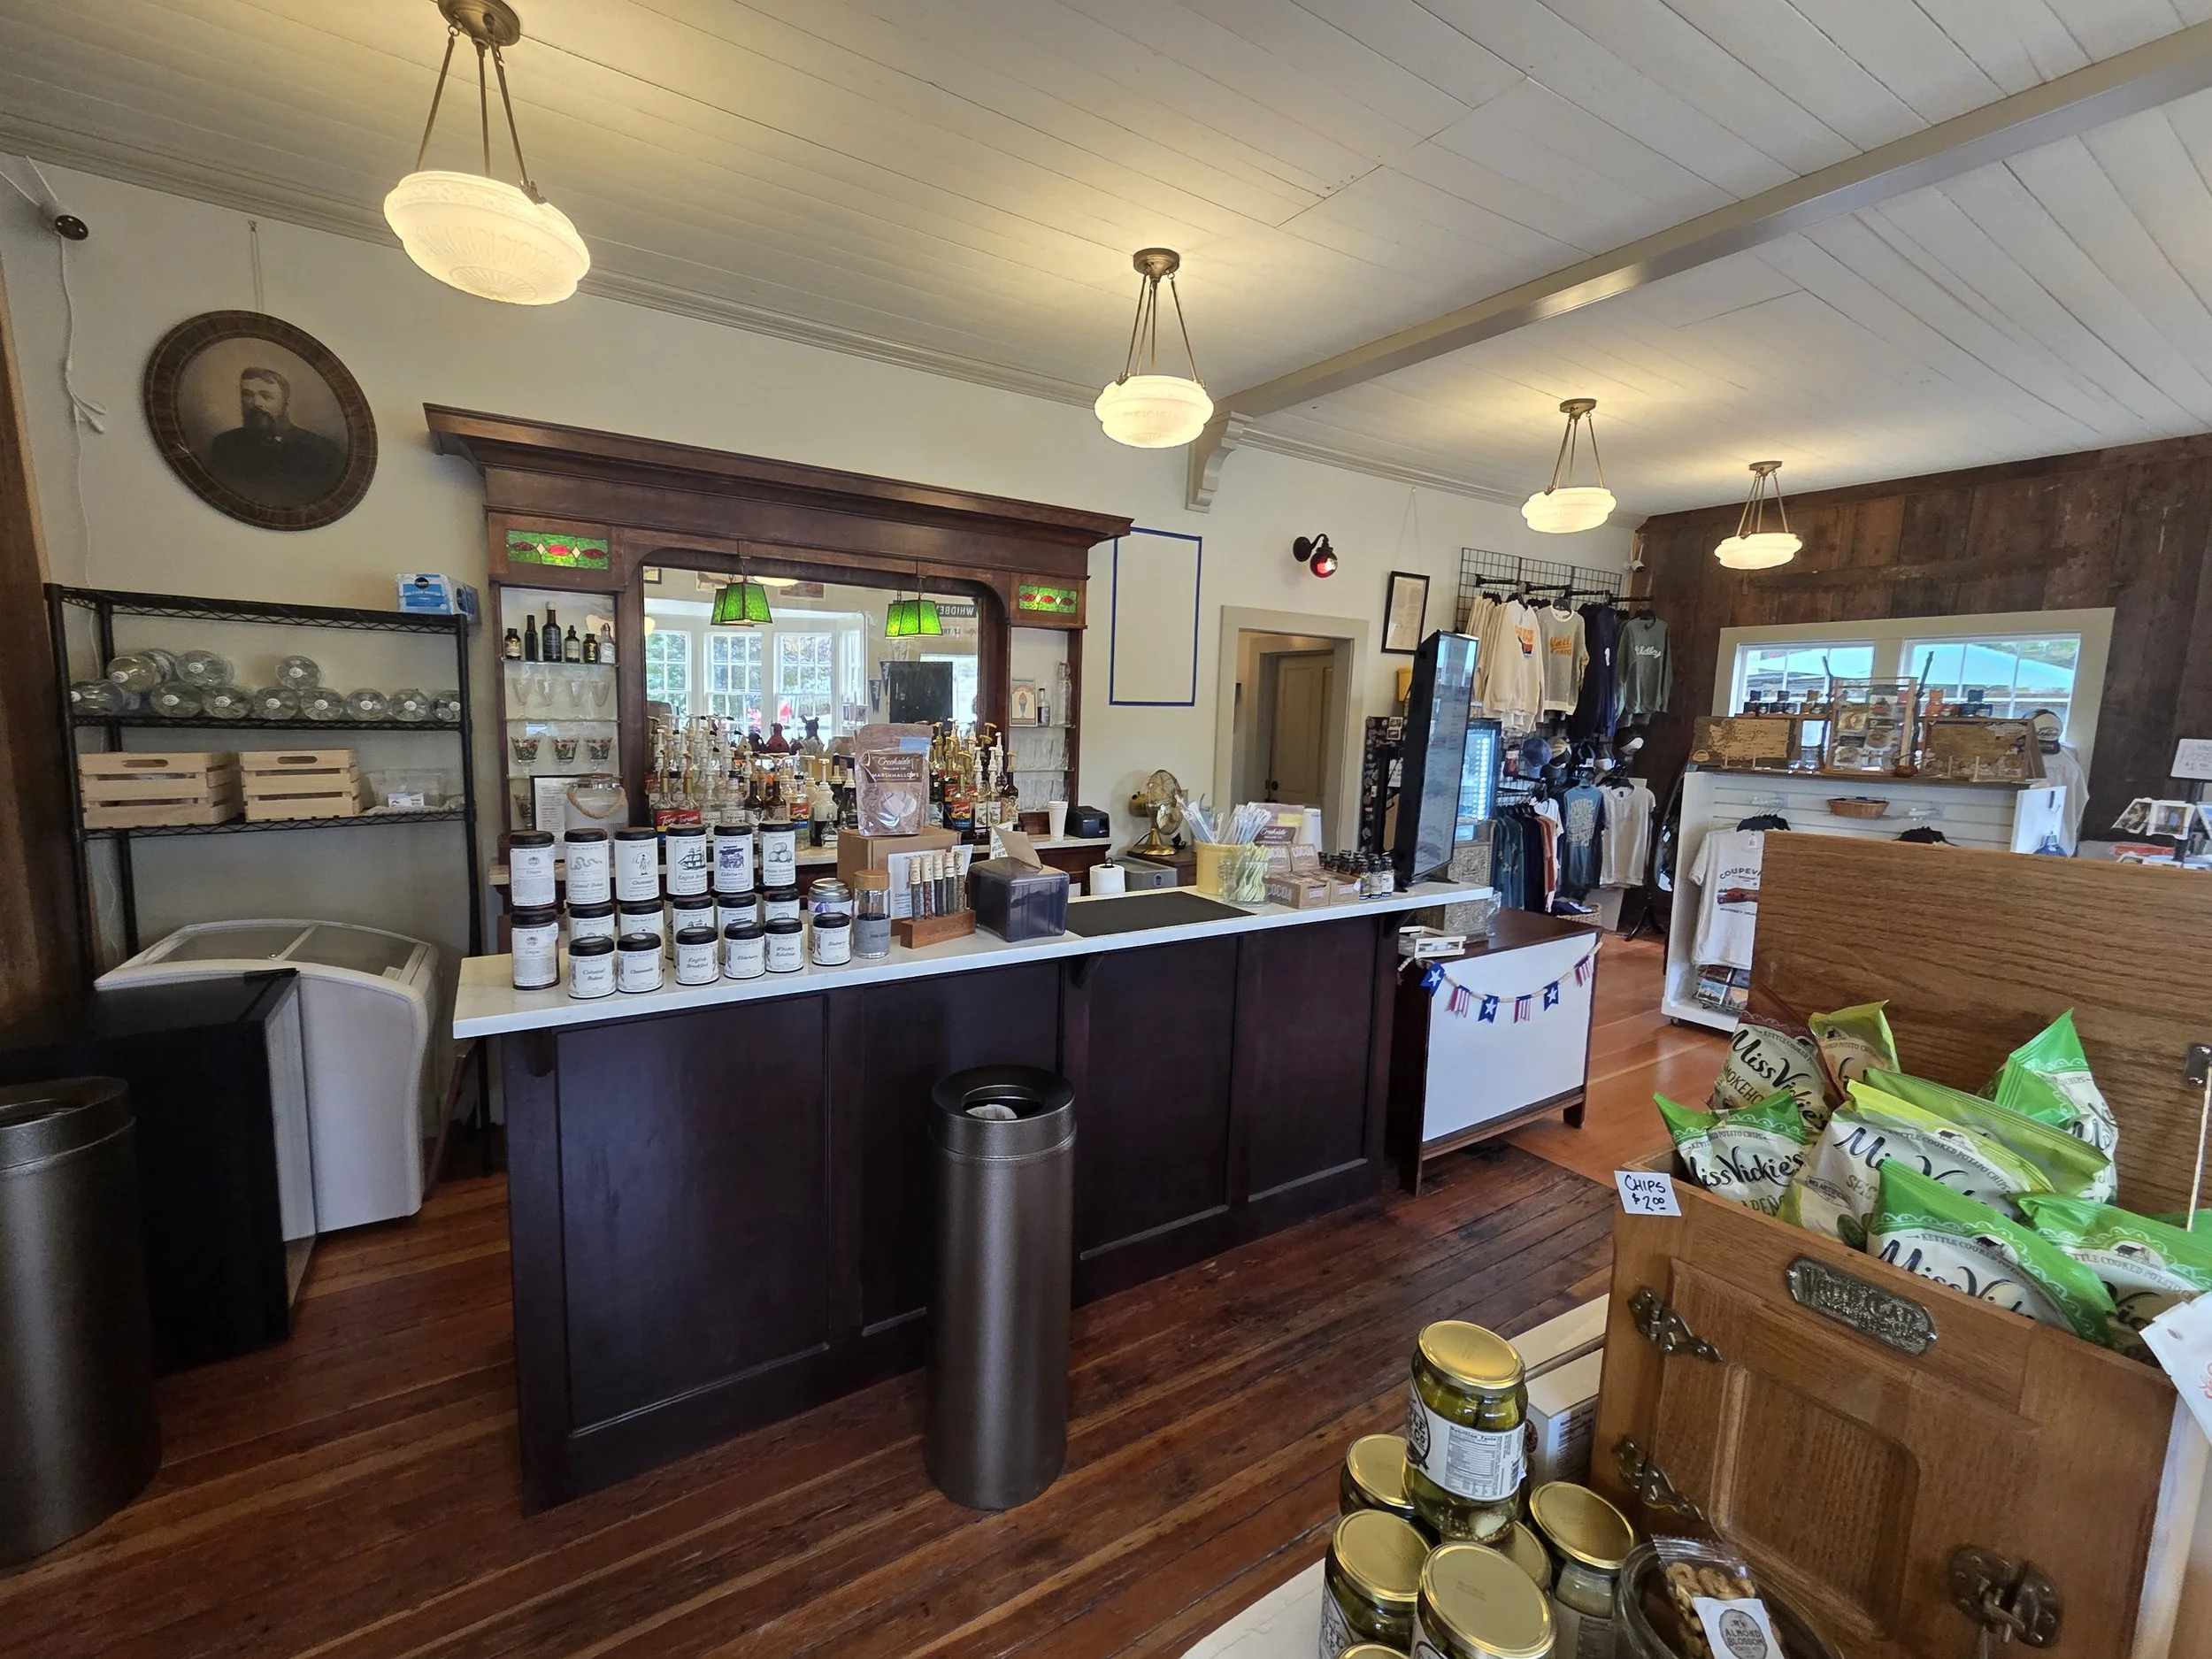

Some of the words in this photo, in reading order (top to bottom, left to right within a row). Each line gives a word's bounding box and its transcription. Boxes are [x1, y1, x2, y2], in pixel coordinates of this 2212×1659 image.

[873, 756, 911, 767] Creekside
[1292, 846, 1315, 857] COCOA
[1921, 1137, 1957, 1155] COOKED
[1956, 1151, 1988, 1173] POTATO
[1715, 1145, 1804, 1188] Vickie's
[1624, 1174, 1666, 1194] CHIPS
[1921, 1233, 1959, 1247] KETTLE
[2101, 1256, 2143, 1275] COOKED
[1725, 1627, 1761, 1638] ALMOND
[1726, 1637, 1763, 1647] BLOSSOM
